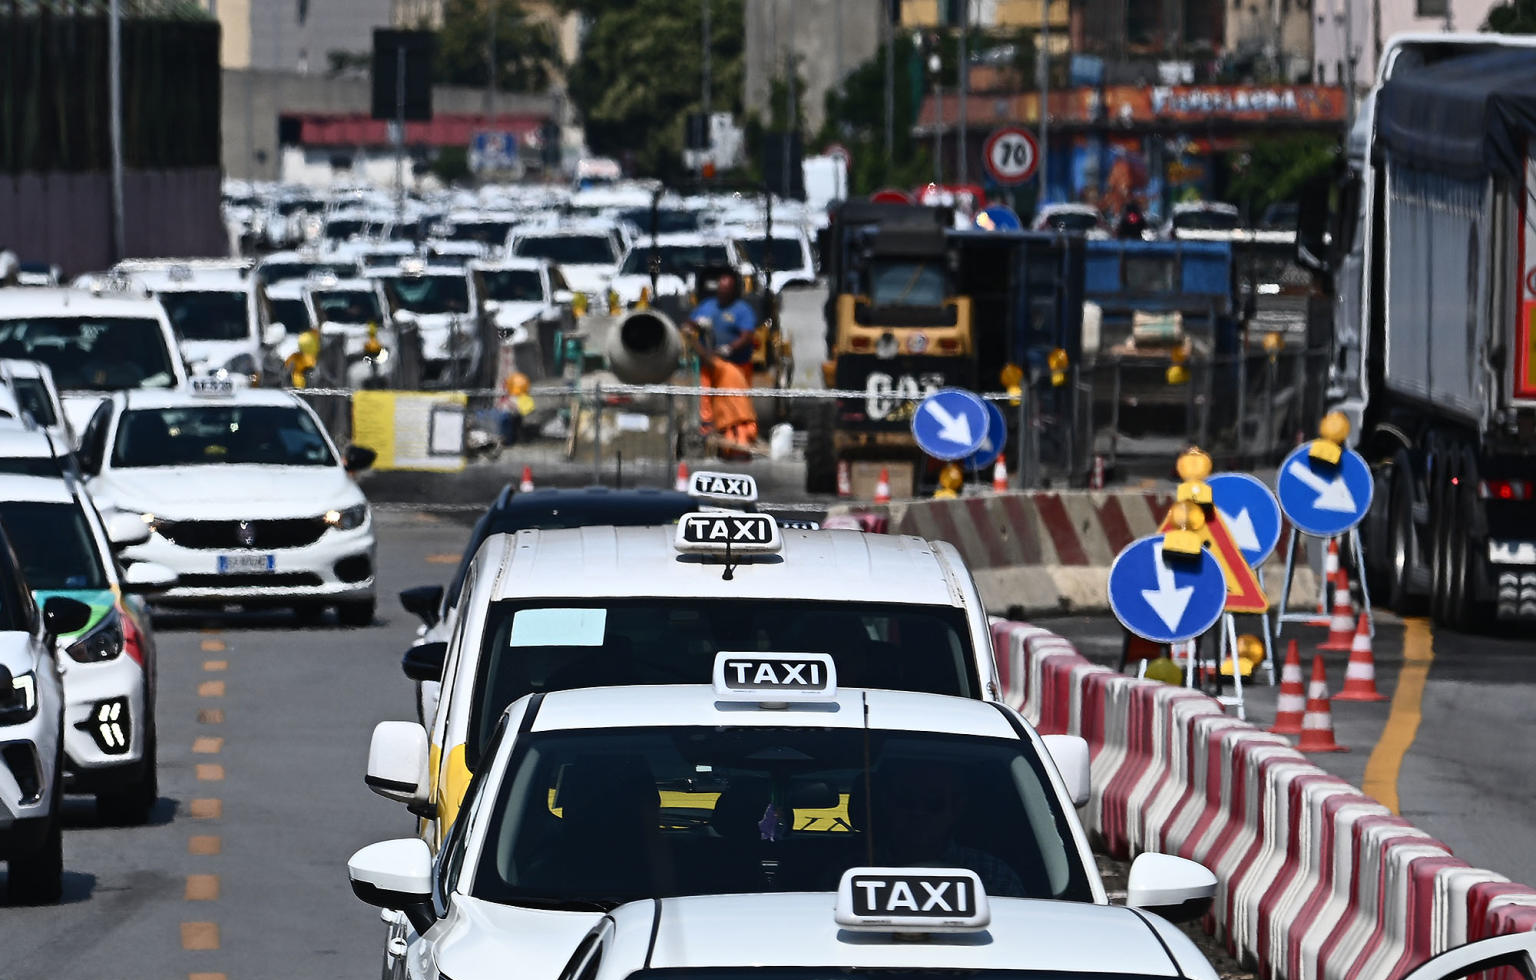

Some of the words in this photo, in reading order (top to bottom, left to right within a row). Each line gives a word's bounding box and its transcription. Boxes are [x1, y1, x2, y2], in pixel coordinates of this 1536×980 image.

[1001, 141, 1027, 168] 70
[696, 476, 750, 496] TAXI
[690, 519, 765, 540] TAXI
[728, 662, 820, 685] TAXI
[855, 880, 967, 912] TAXI
